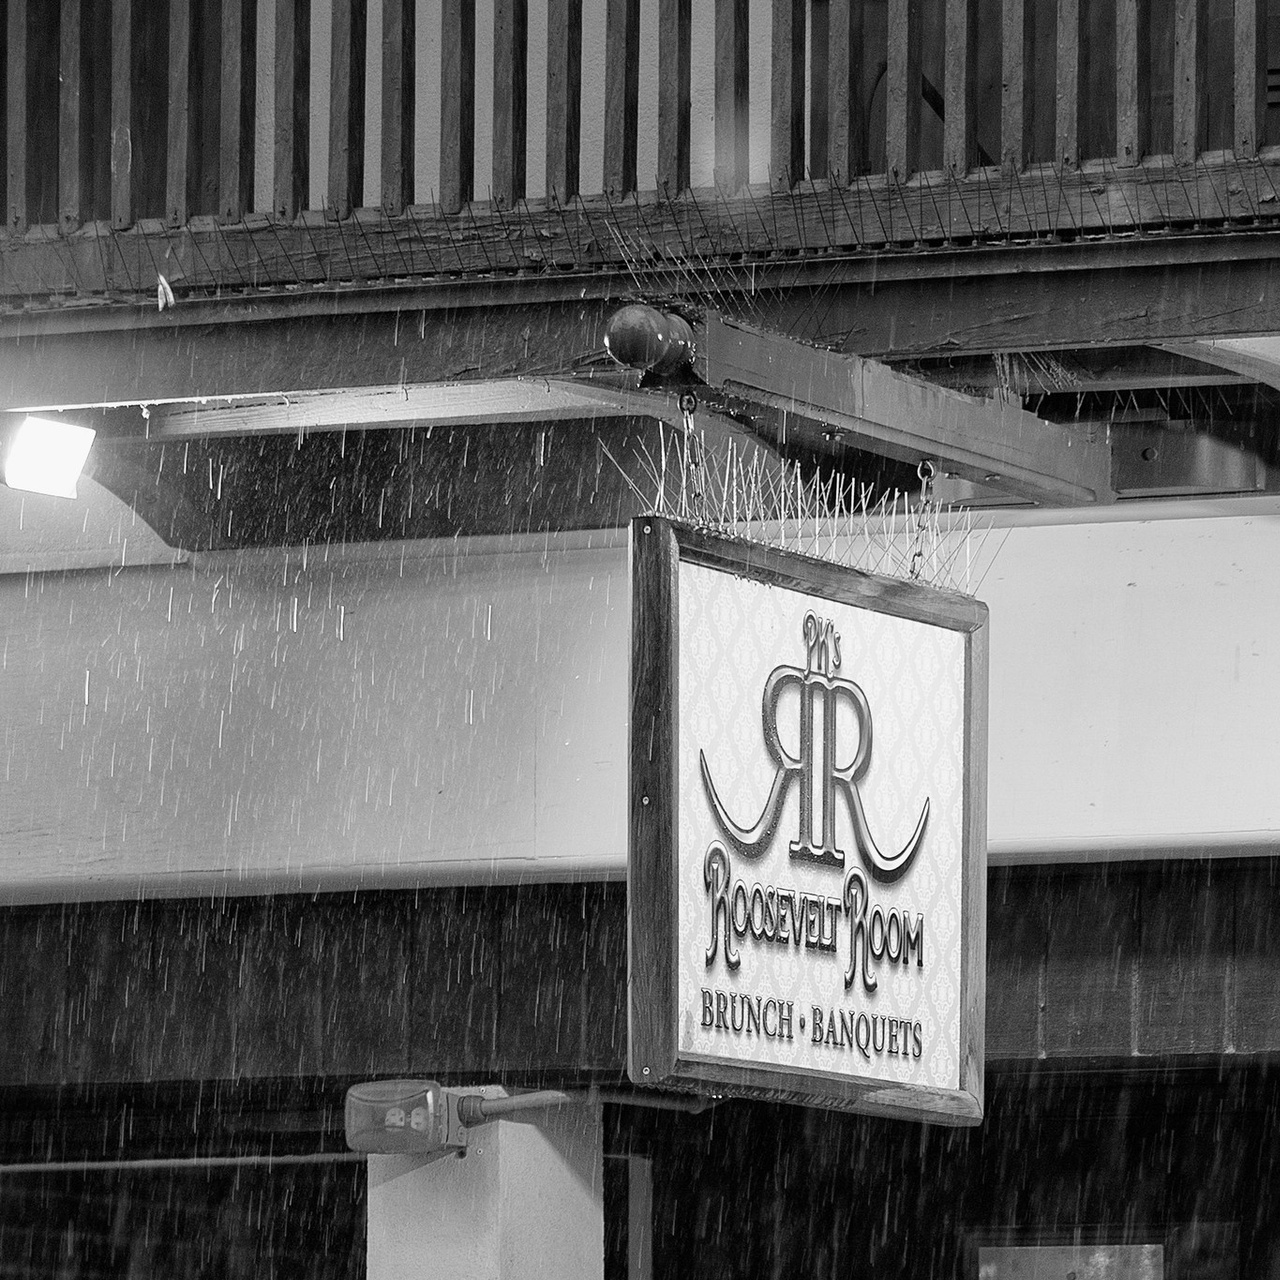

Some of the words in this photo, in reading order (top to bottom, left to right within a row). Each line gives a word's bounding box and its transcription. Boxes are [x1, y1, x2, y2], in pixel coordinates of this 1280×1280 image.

[703, 839, 842, 970] ROOSEVELT
[843, 866, 924, 992] ROOM
[701, 987, 794, 1039] BRUNCH
[811, 1004, 923, 1058] BANQUETS
